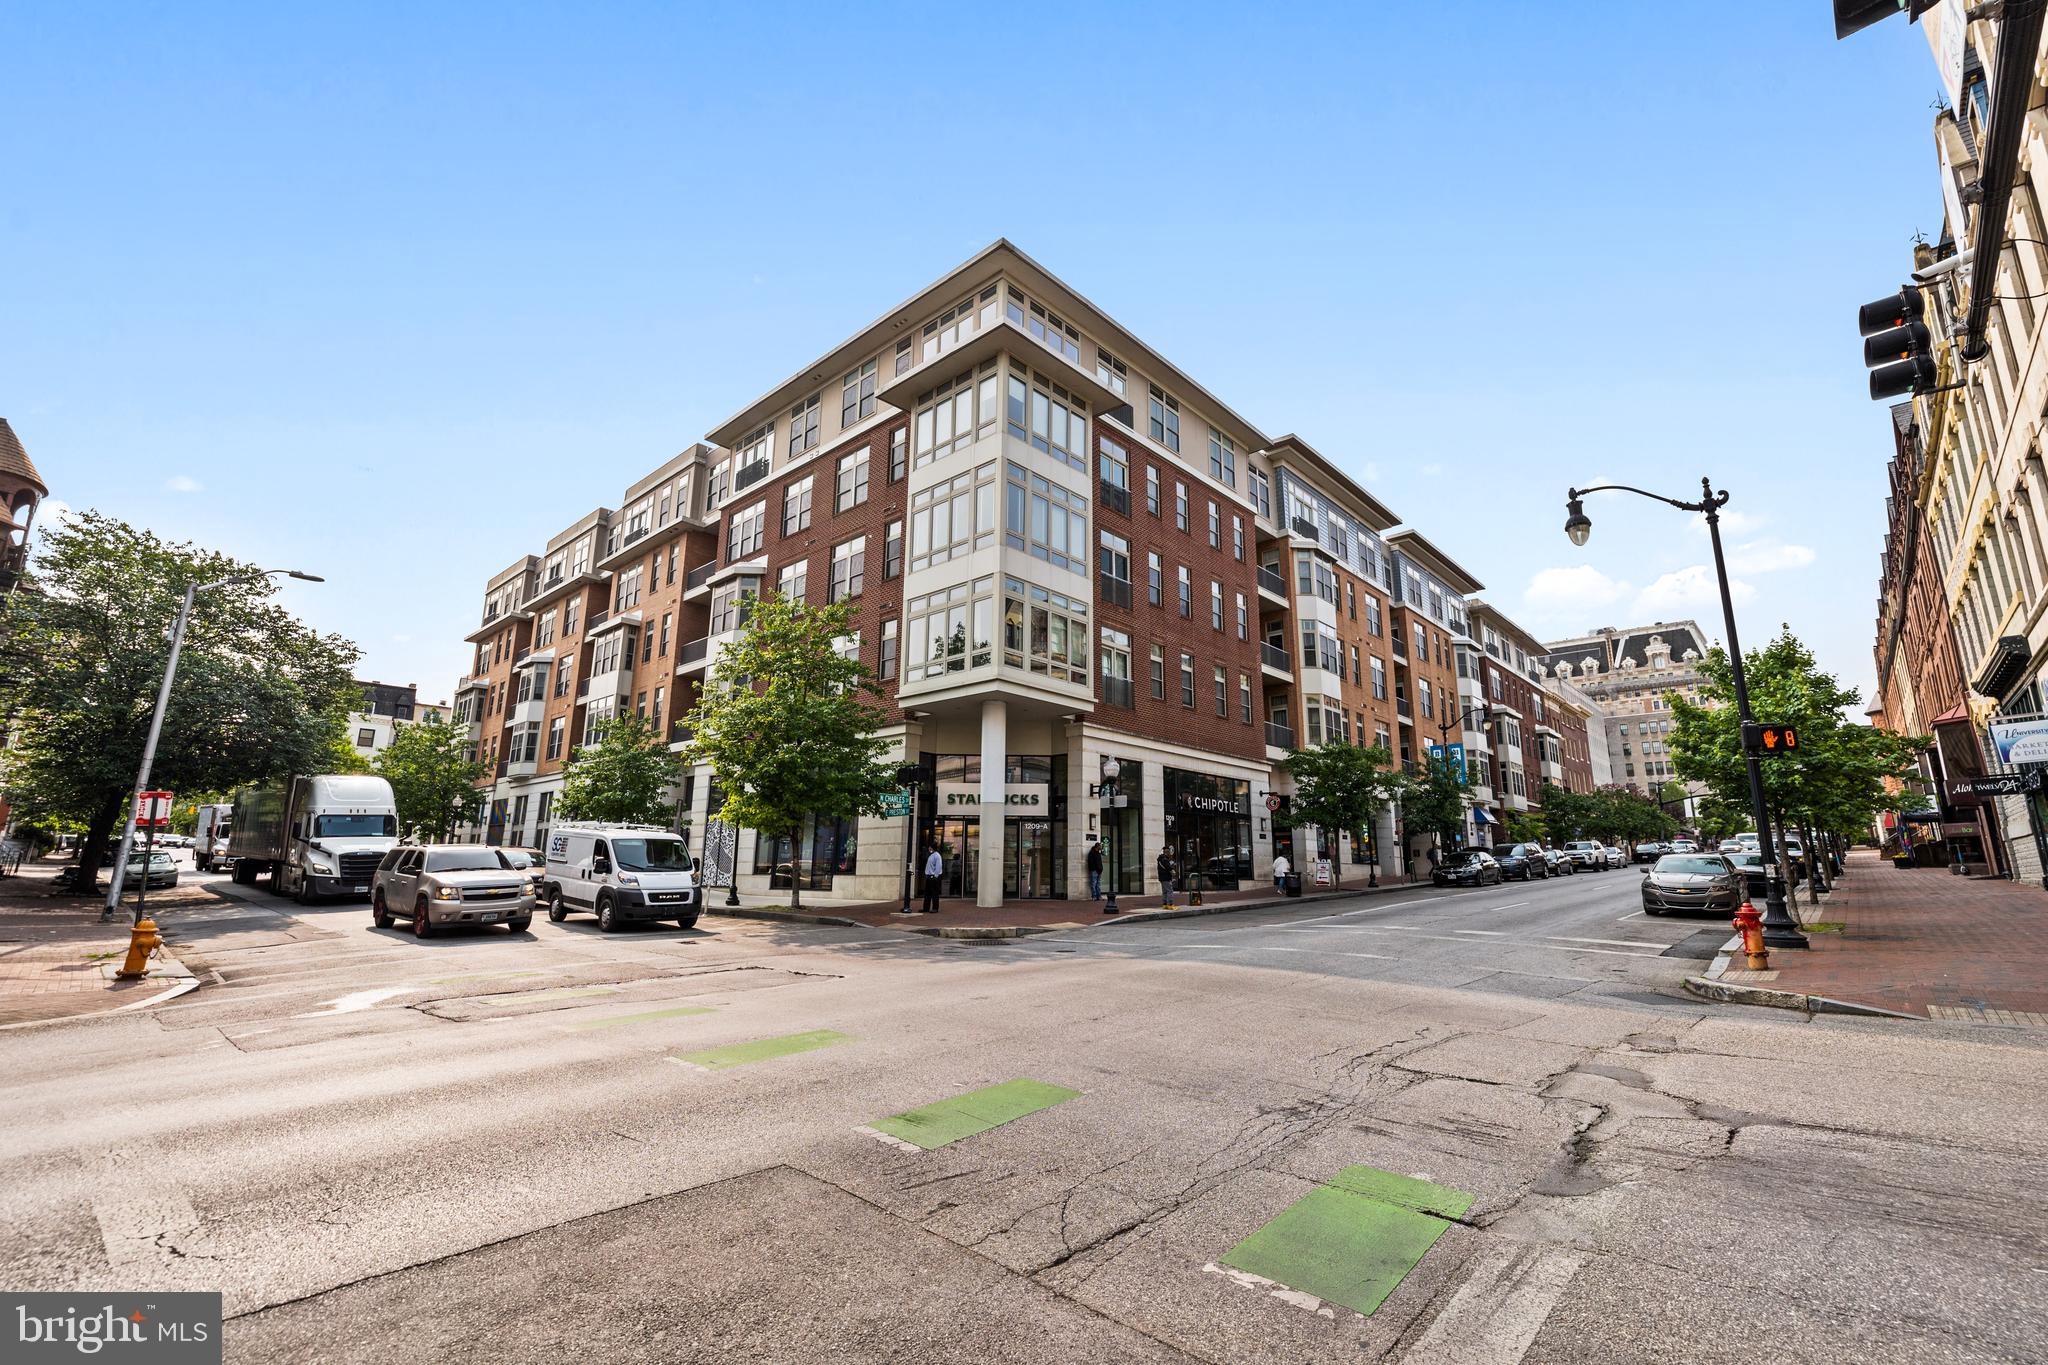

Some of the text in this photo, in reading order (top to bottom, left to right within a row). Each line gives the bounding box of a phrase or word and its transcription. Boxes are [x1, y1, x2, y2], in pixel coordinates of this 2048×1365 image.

[1785, 730, 1795, 746] 8
[885, 795, 905, 804] CHARLES
[947, 793, 1040, 806] STACKS
[1194, 796, 1239, 814] CHIPOTLE
[890, 808, 905, 816] PRESTON
